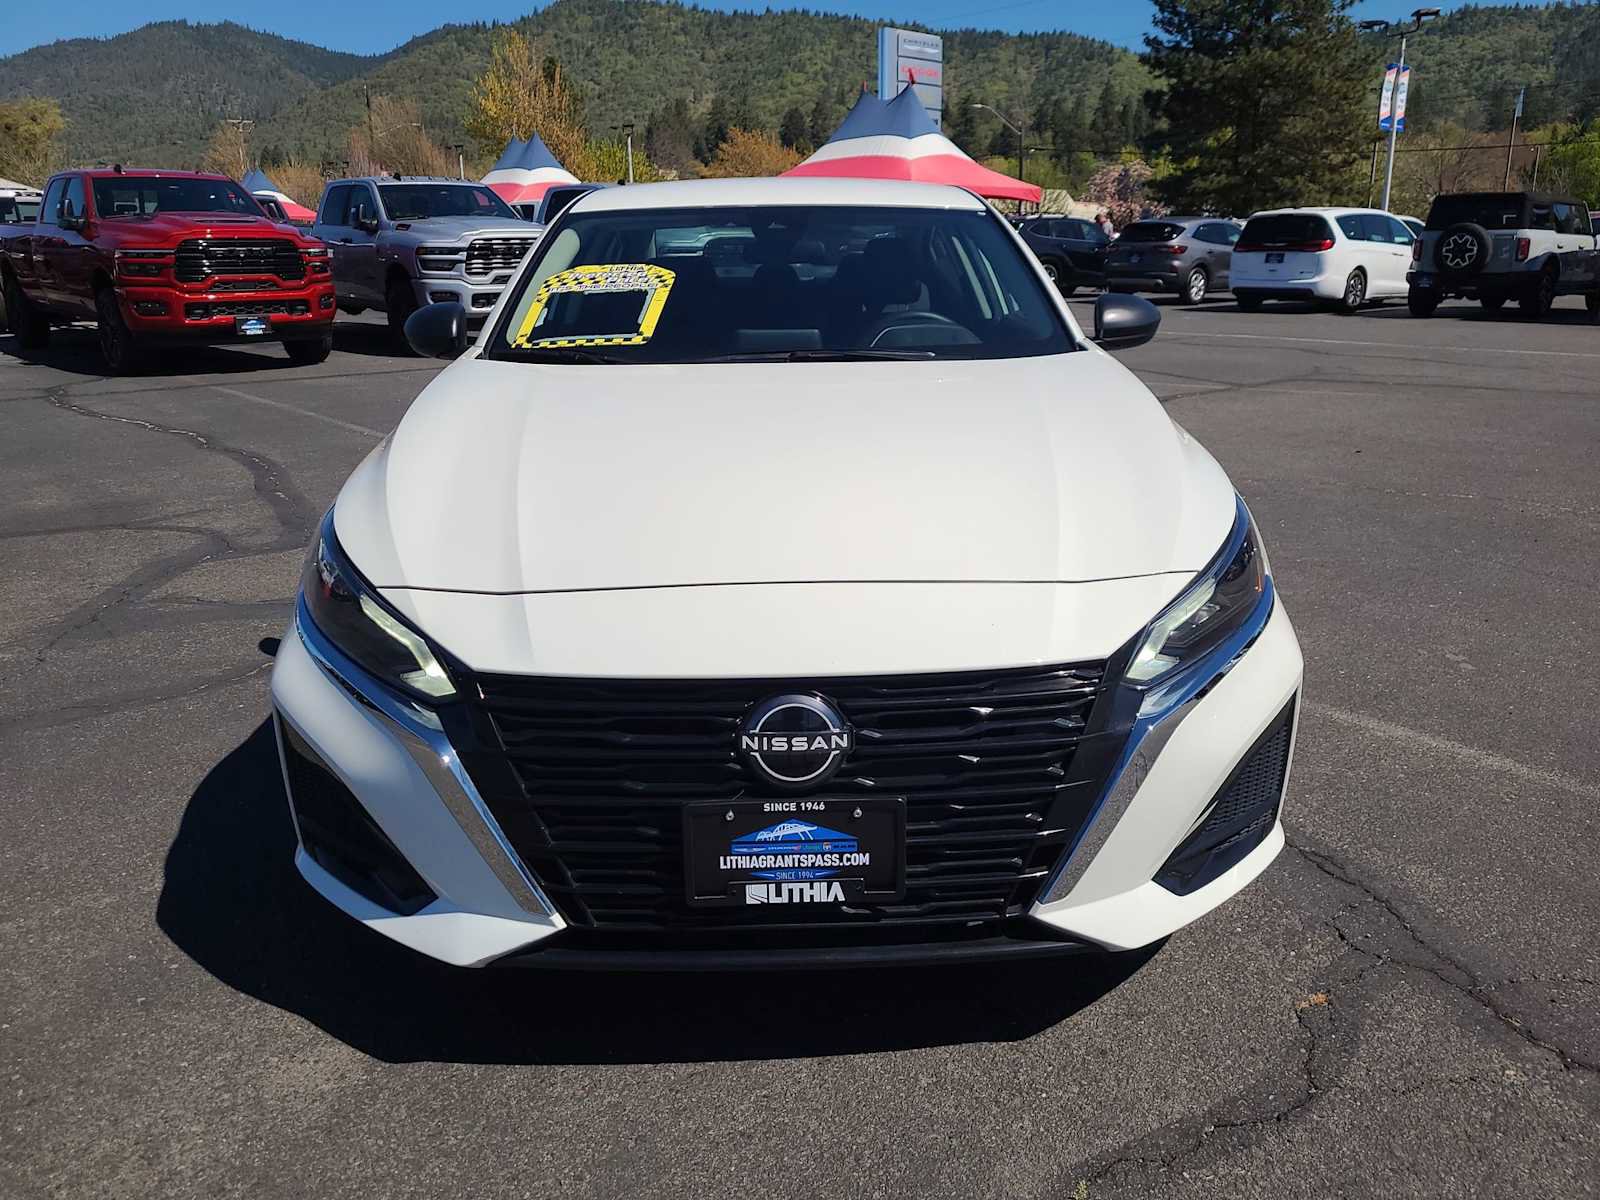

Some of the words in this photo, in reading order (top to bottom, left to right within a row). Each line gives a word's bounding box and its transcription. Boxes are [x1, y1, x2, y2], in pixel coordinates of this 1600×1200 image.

[742, 734, 848, 751] NISSAN
[763, 802, 797, 812] SINCE
[800, 801, 826, 811] 1946
[719, 853, 870, 870] LITHIAGRANTSPASS.COM
[775, 871, 797, 880] SINCE
[798, 871, 815, 879] 1994
[767, 881, 846, 904] LITHIA
